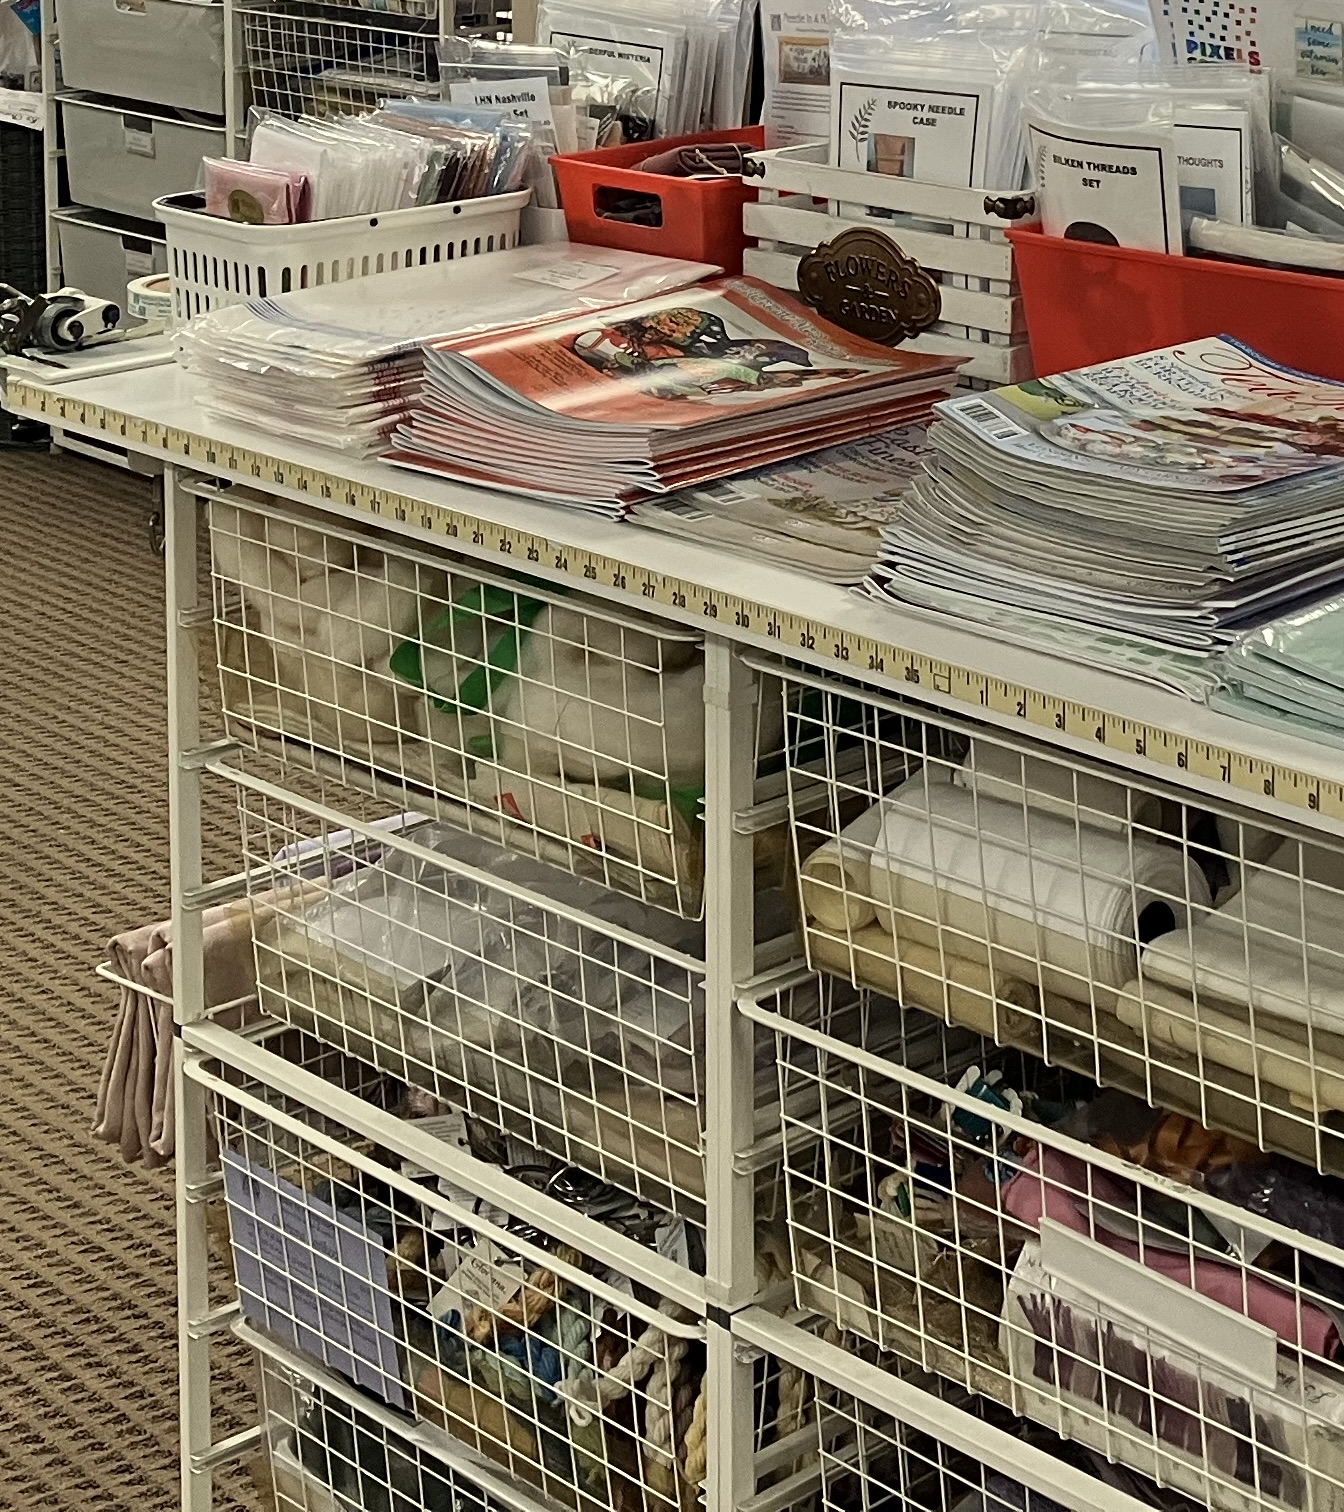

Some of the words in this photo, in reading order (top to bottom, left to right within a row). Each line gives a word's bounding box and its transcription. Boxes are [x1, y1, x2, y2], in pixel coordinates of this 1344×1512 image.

[474, 93, 493, 106] LHN
[494, 91, 536, 104] Nashville
[887, 100, 925, 113] SPOOKY
[927, 104, 966, 117] NEEDLE
[912, 116, 938, 128] CASE
[1052, 153, 1084, 170] SILKEN
[1085, 159, 1138, 176] THREADS
[1177, 155, 1224, 169] THOUGHTS
[1081, 177, 1102, 189] SET
[823, 253, 911, 299] FLOWERS
[839, 298, 899, 323] GARDEN
[979, 690, 985, 705] 1
[1016, 700, 1025, 717] 2
[1055, 713, 1063, 729] 3
[1094, 726, 1103, 743] 4
[1135, 738, 1143, 755] 5
[1177, 751, 1186, 769] 6
[1220, 765, 1228, 783] 7
[1263, 778, 1272, 796] 8
[1307, 792, 1317, 810] 9
